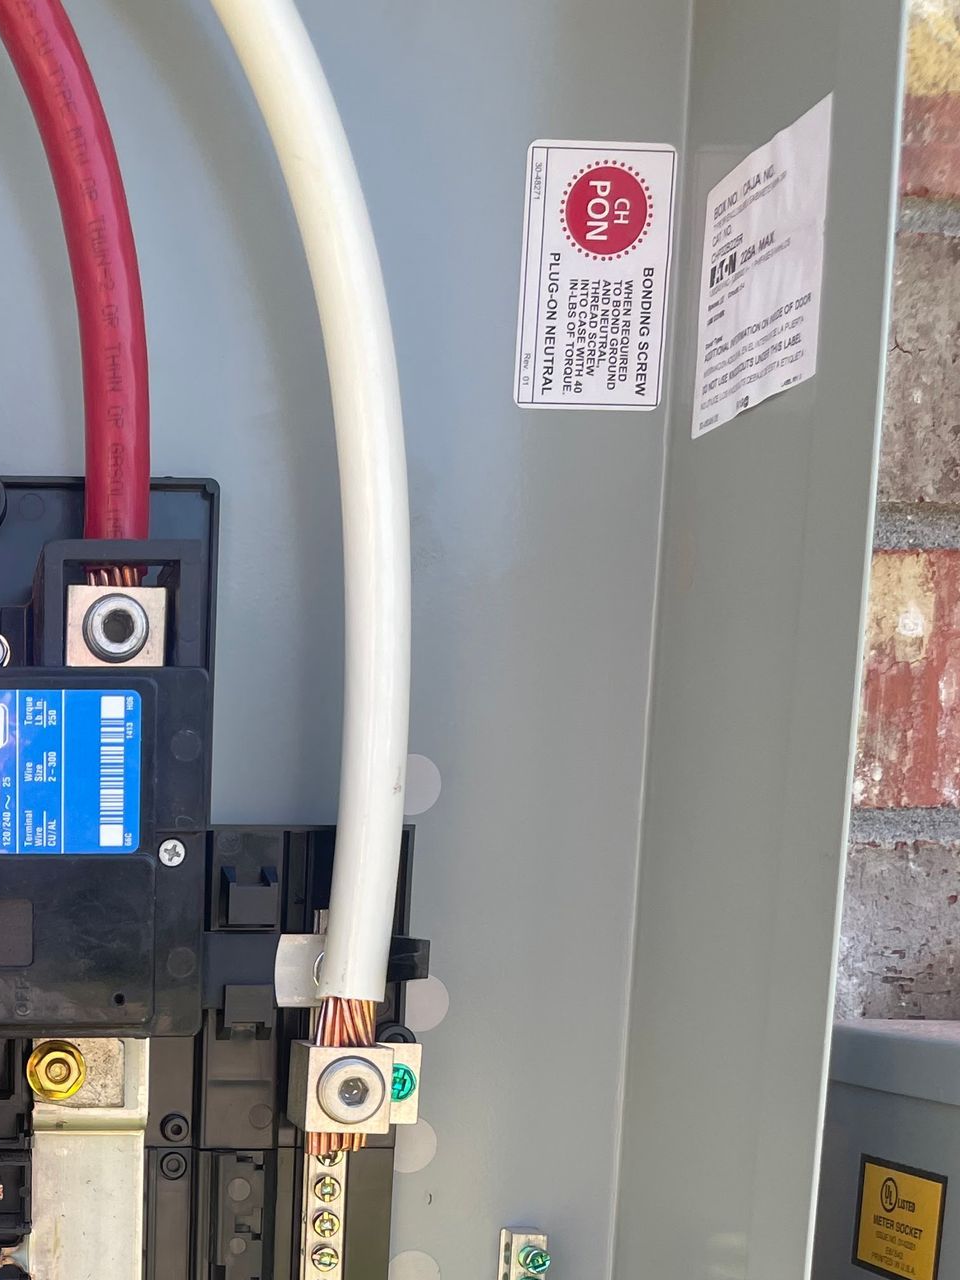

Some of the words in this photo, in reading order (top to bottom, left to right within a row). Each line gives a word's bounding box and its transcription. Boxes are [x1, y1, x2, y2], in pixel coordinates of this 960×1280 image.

[586, 180, 611, 241] PON
[613, 198, 631, 224] CH
[713, 200, 727, 221] BOX
[546, 253, 560, 320] PLUG-ON
[567, 279, 579, 318] IN-LBS
[579, 279, 589, 307] INTO
[602, 279, 611, 305] AND
[613, 280, 623, 297] TO
[622, 280, 634, 316] WHEN
[589, 279, 600, 328] THREAD
[638, 267, 655, 337] BONDING
[566, 322, 575, 338] OF
[577, 311, 587, 344] CASE
[611, 300, 621, 335] BOND
[522, 353, 531, 371] Rev.
[541, 325, 556, 395] NEUTRAL
[575, 346, 585, 377] WITH
[586, 332, 597, 377] SCREW
[607, 338, 619, 390] GROUND
[618, 320, 631, 382] REQUIRED
[522, 375, 530, 386] 01
[562, 342, 575, 395] TORQUE.
[634, 341, 650, 396] SCREW
[573, 380, 583, 393] 40
[24, 696, 33, 726] Torque
[34, 698, 43, 710] In.
[48, 709, 57, 726] 250
[34, 711, 43, 726] Lb.
[126, 722, 134, 739] 1413
[2, 776, 11, 788] 25
[24, 761, 33, 782] Wire
[34, 764, 43, 782] Size
[2, 811, 11, 846] 120/240
[24, 810, 33, 847] Terminal
[34, 826, 43, 847] Wire
[48, 819, 57, 847] CU/AL
[897, 1197, 916, 1213] LISTED
[873, 1214, 895, 1230] METER
[895, 1221, 923, 1241] SOCKET
